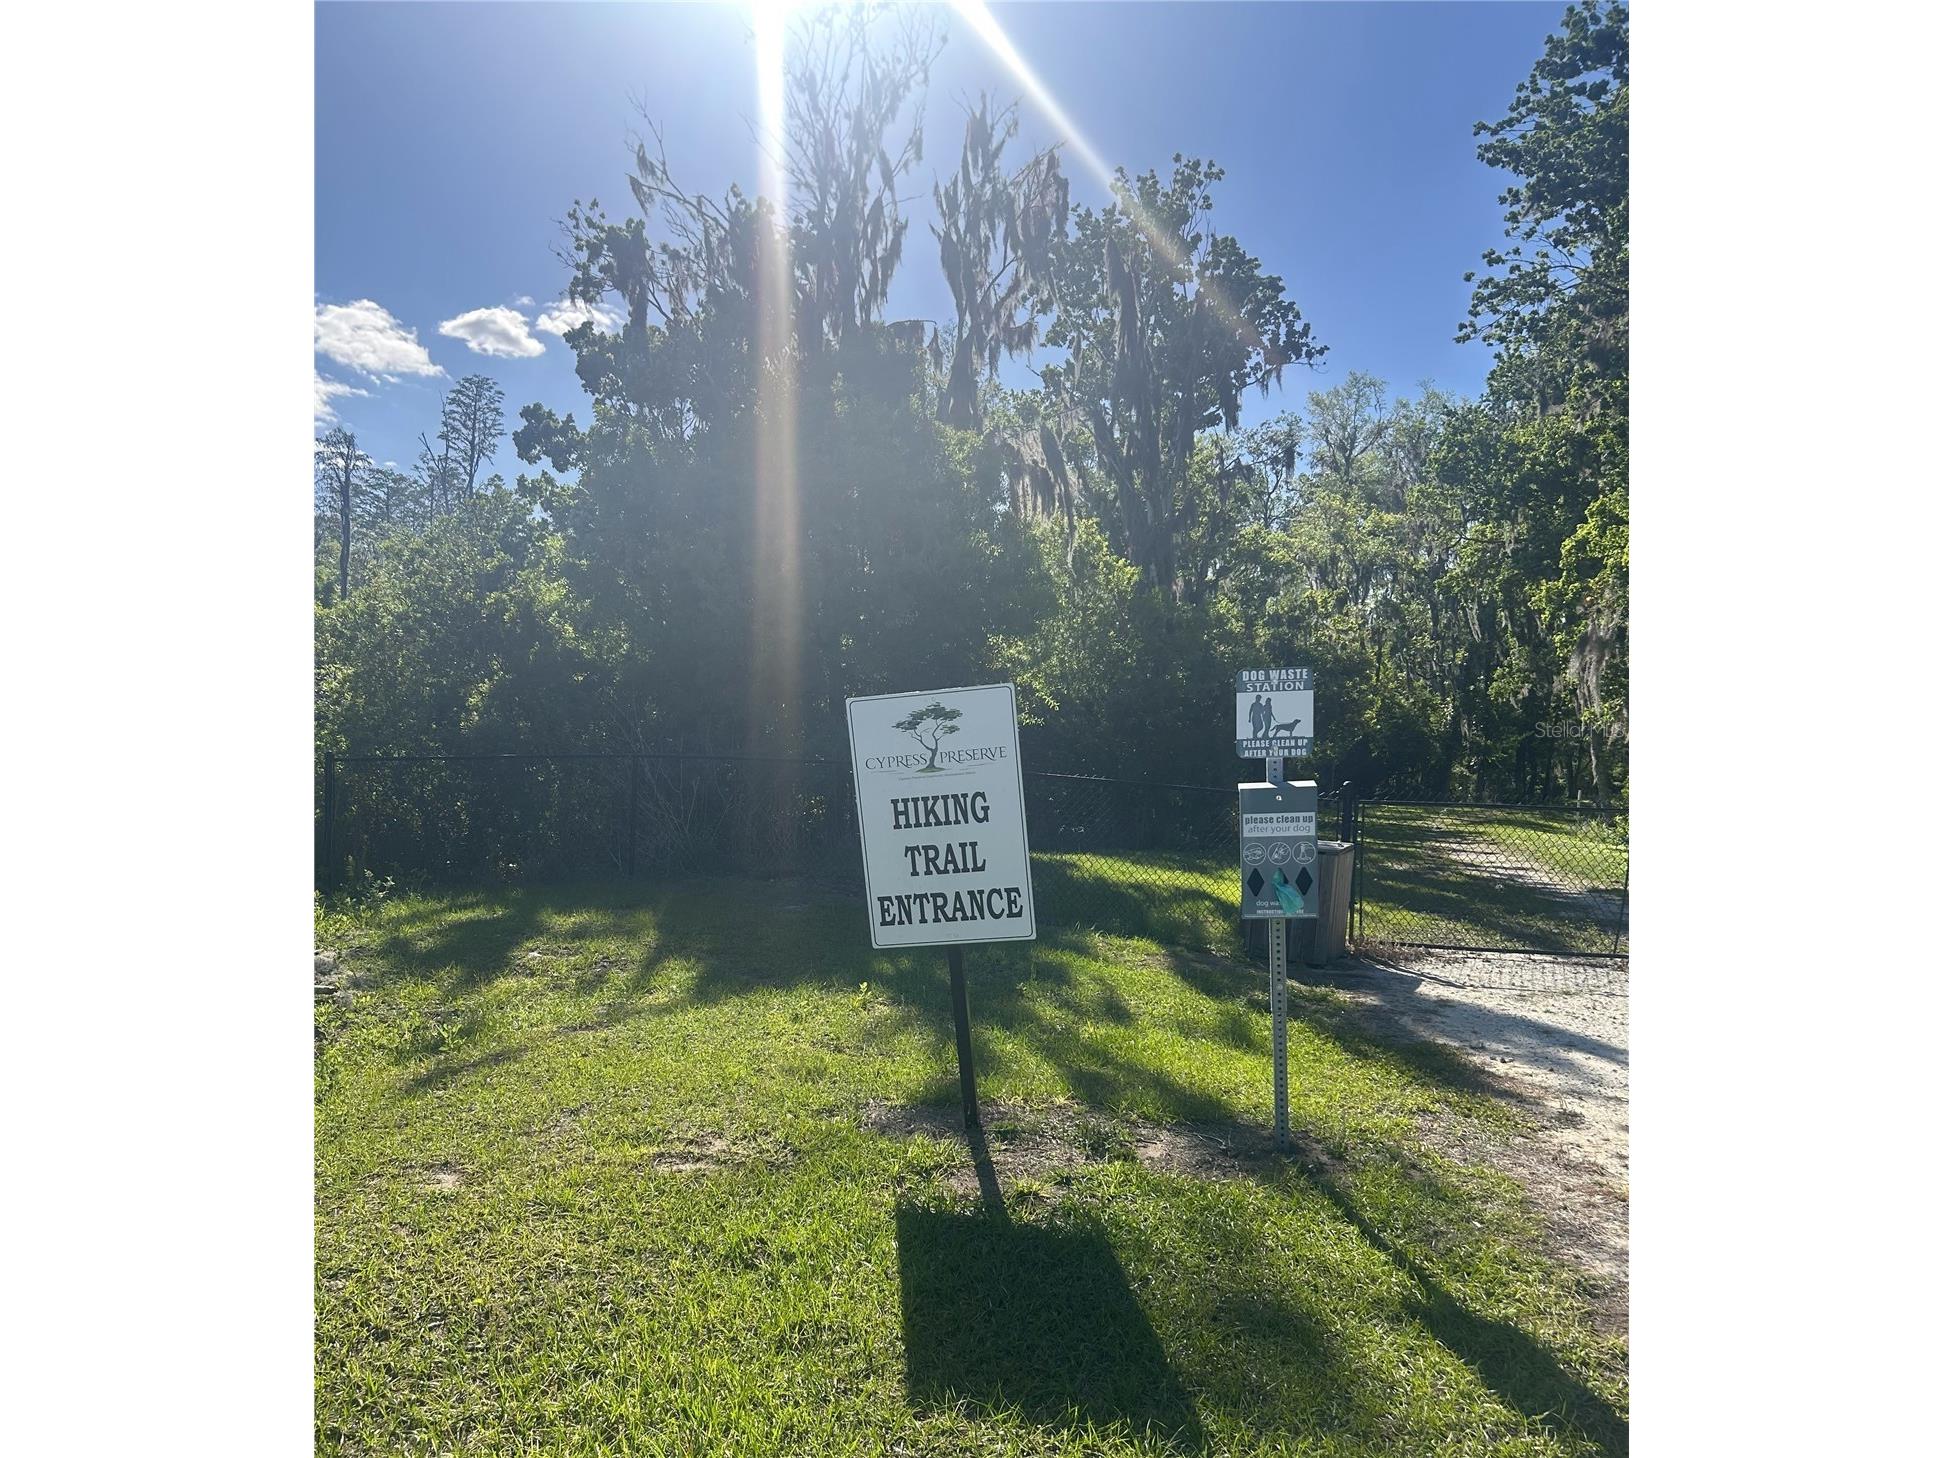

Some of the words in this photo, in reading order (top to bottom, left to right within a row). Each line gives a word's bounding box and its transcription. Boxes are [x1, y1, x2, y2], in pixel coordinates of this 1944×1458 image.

[1242, 670, 1265, 681] DOG
[1269, 668, 1308, 680] WASTE
[1246, 681, 1304, 691] STATION
[865, 753, 928, 770] CYPRESS
[939, 746, 1008, 763] PRESERVE
[1244, 749, 1267, 757] AFTER
[1268, 748, 1289, 756] YOUR
[1291, 748, 1307, 756] DOG
[890, 791, 990, 830] HIKING
[1244, 816, 1274, 825] please
[1276, 815, 1300, 823] clean
[1302, 815, 1314, 823] up
[1247, 825, 1269, 833] after
[1270, 825, 1291, 834] your
[1293, 824, 1311, 833] dog
[904, 841, 986, 877] TRAIL
[877, 886, 1024, 927] ENTRANCE
